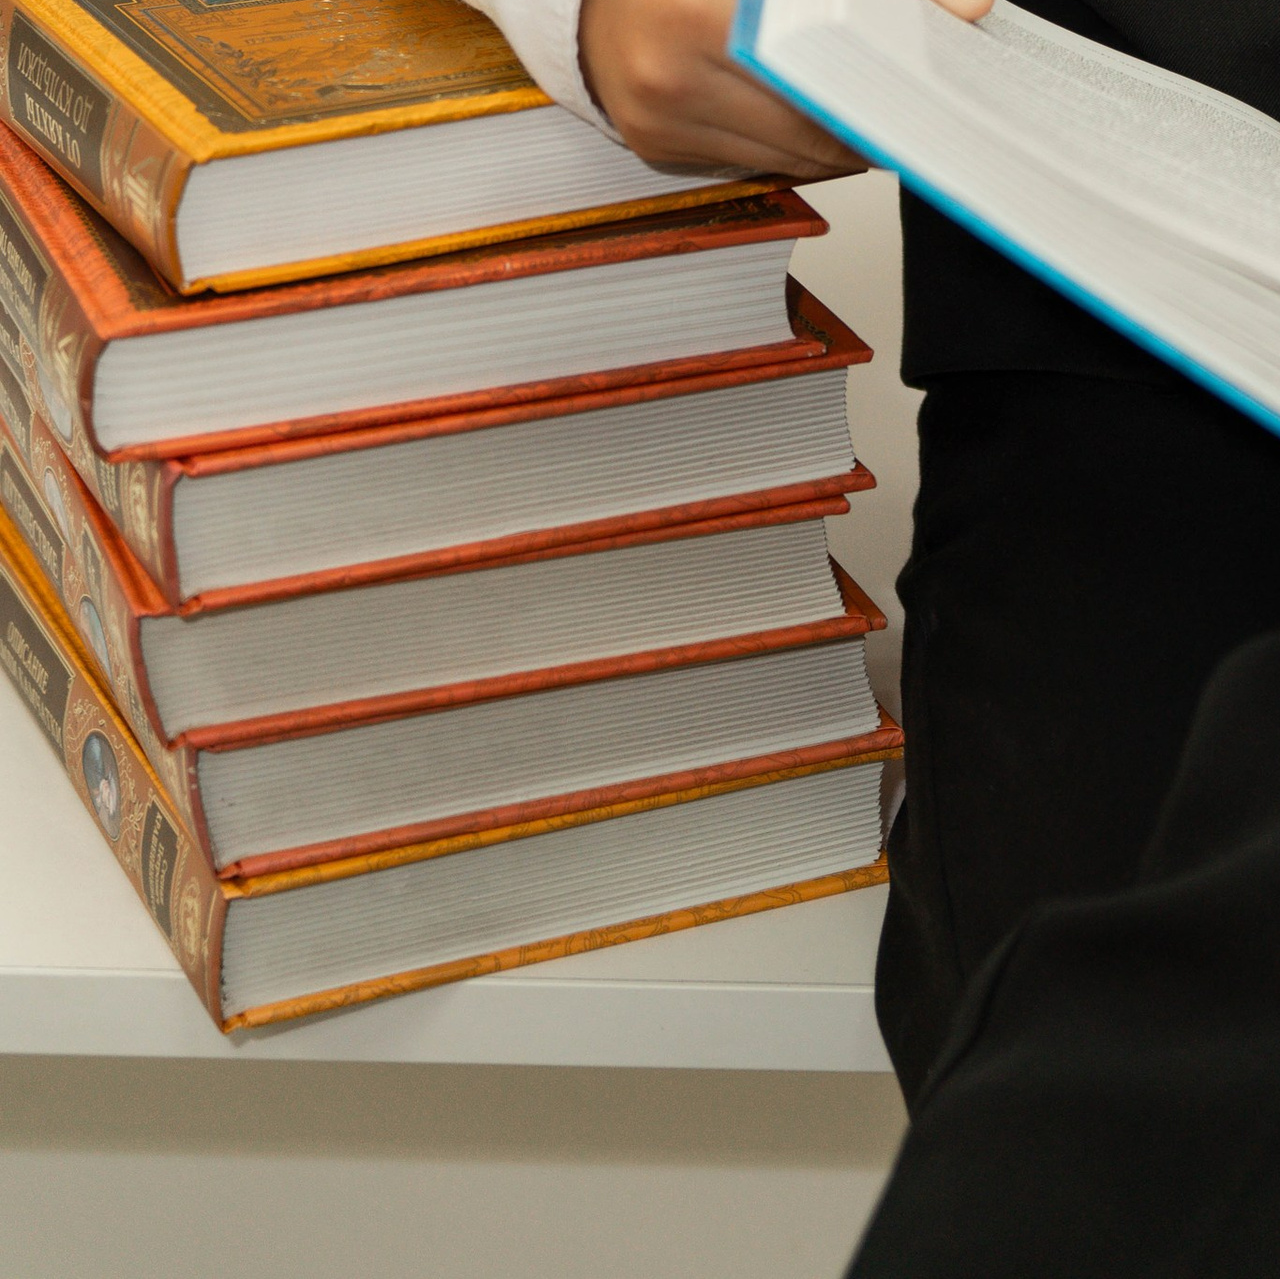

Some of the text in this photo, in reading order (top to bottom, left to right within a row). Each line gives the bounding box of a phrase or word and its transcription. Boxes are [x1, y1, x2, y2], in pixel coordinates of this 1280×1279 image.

[17, 42, 95, 135] ДО КУЛЬДЖИ
[24, 92, 81, 169] ОТ КЯХТЫ
